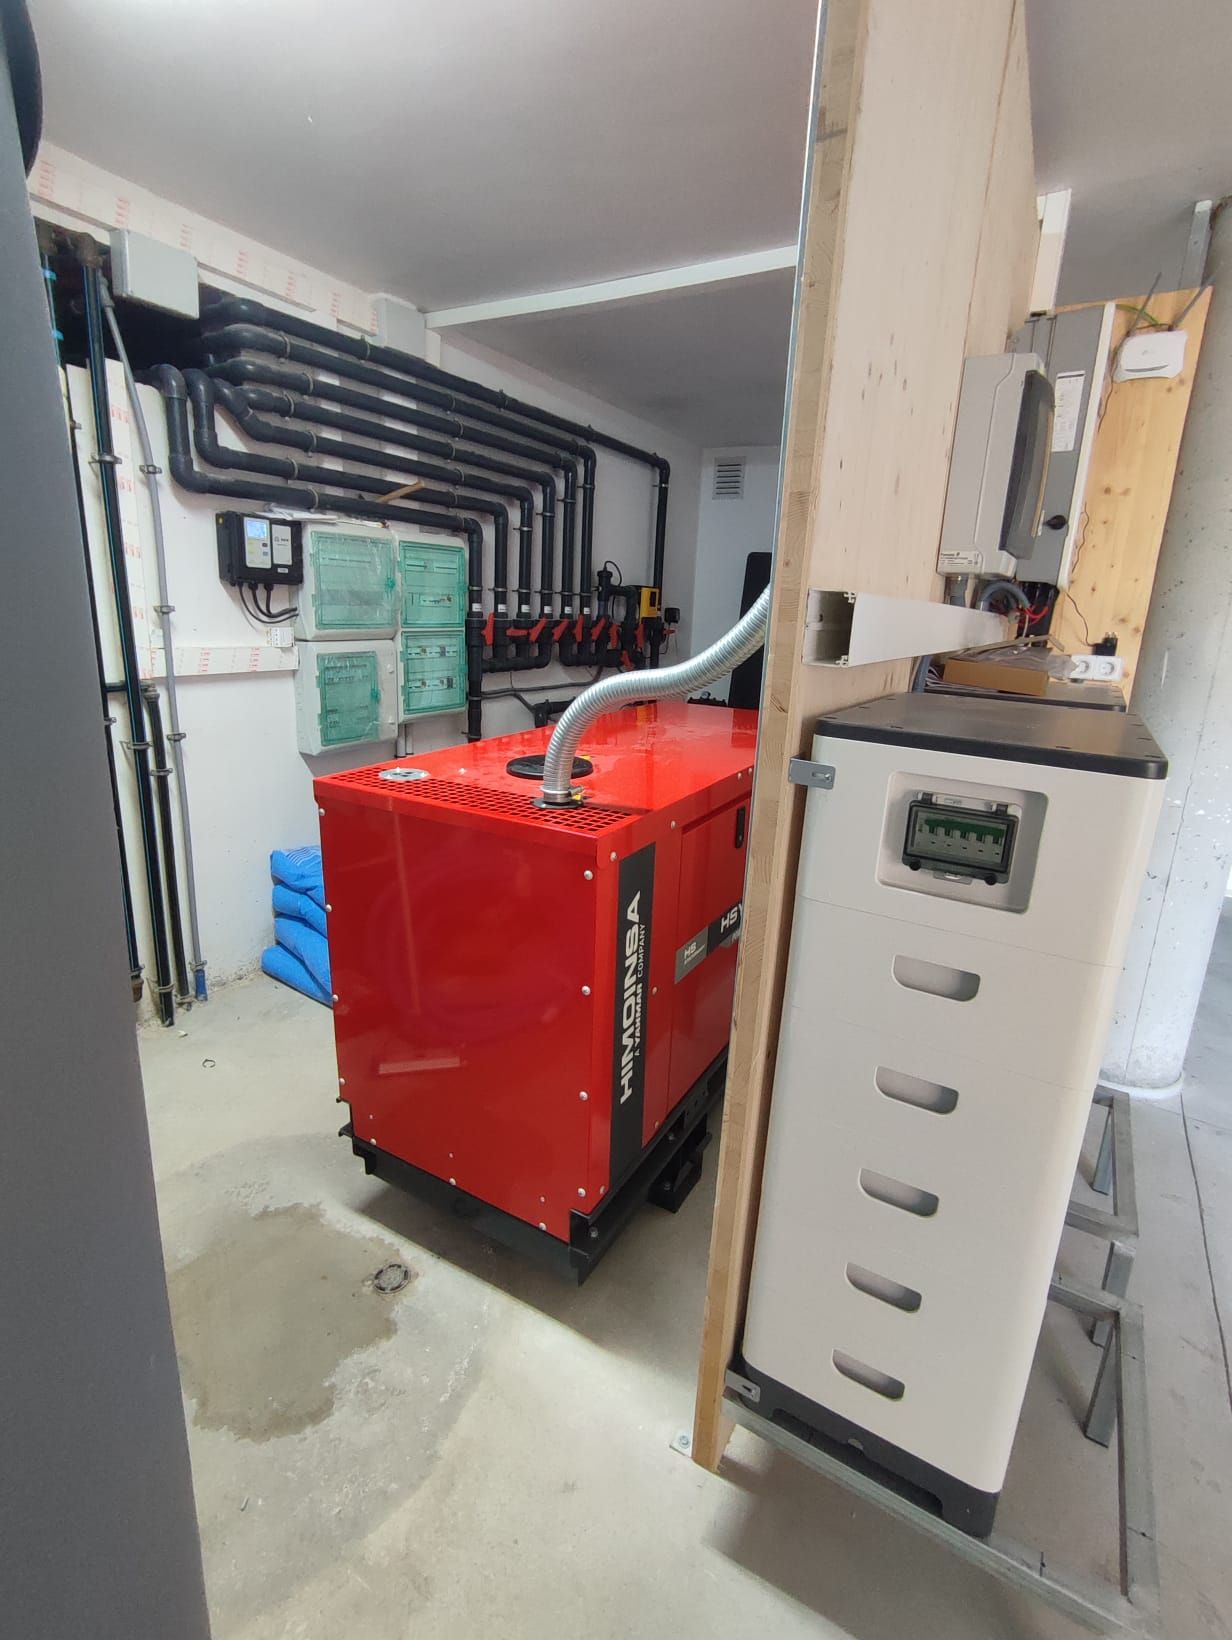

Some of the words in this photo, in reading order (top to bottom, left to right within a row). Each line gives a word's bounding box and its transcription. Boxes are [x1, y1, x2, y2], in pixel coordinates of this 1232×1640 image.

[637, 924, 646, 978] COMPANY
[684, 942, 697, 959] HS
[620, 891, 641, 1105] HIMOINSA
[634, 983, 643, 1046] YANMAR
[633, 1048, 640, 1056] A
